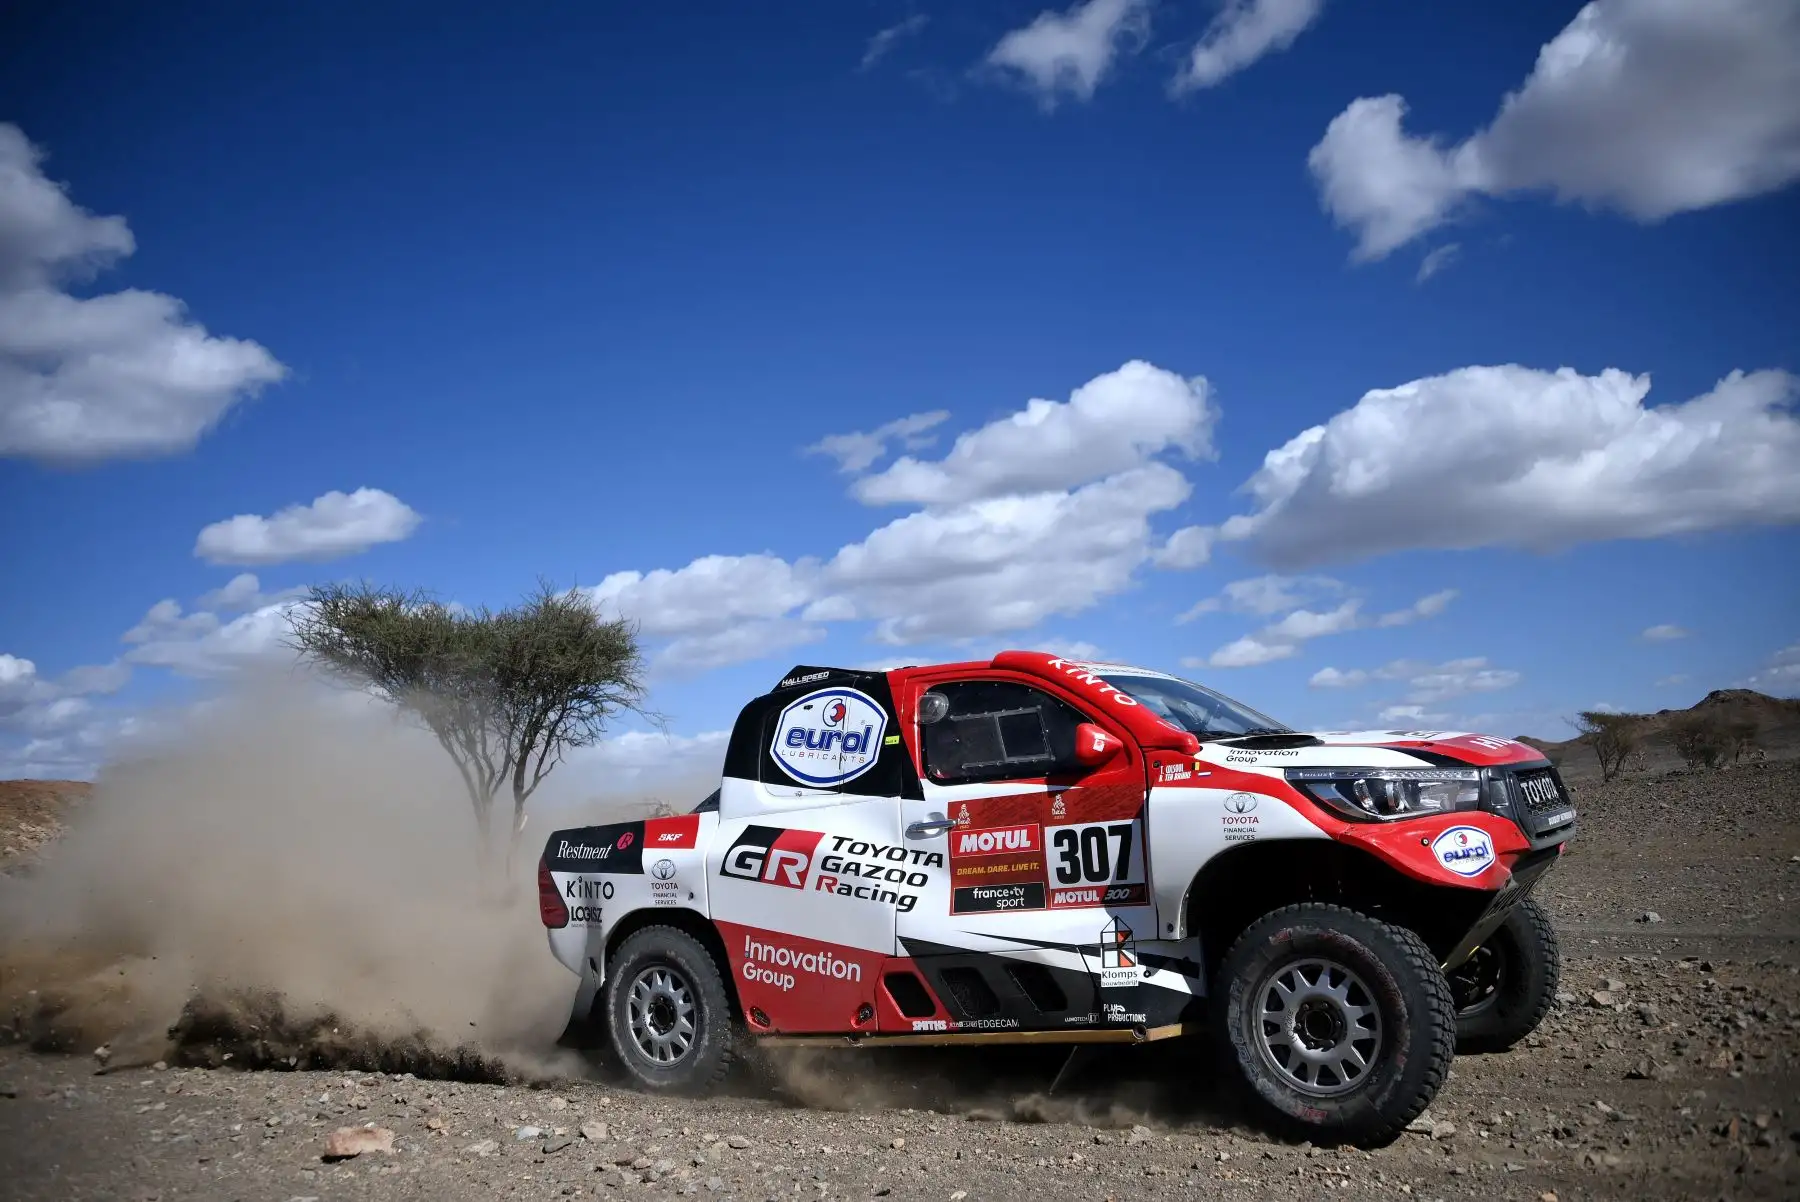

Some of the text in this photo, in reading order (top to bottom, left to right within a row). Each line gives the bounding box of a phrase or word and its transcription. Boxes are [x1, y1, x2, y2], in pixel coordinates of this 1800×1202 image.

[781, 671, 830, 687] HALLSPEED
[1047, 658, 1138, 706] KINTO
[785, 724, 874, 755] eurol
[781, 750, 866, 764] LUBRICANTS
[1225, 754, 1258, 765] Group
[1519, 777, 1559, 805] TOYOTA
[1221, 816, 1260, 825] TOYOTA
[657, 833, 683, 842] SKF
[960, 829, 1031, 853] MOTUL
[556, 840, 613, 860] Restment
[832, 835, 944, 869] TOYOTA
[1053, 823, 1133, 885] 307
[1443, 841, 1490, 863] eurol
[724, 844, 809, 887] GR
[820, 855, 929, 888] GAZOO
[957, 862, 1041, 876] DREAM. DARE. LIVE IT.
[650, 882, 679, 891] TOYOTA
[815, 875, 919, 913] Racing
[996, 896, 1025, 910] sport
[1054, 890, 1100, 905] MOTUL
[744, 934, 862, 983] Innovation
[742, 961, 795, 993] Group
[1101, 970, 1138, 980] Klomps
[978, 1018, 1019, 1029] EDGECAM
